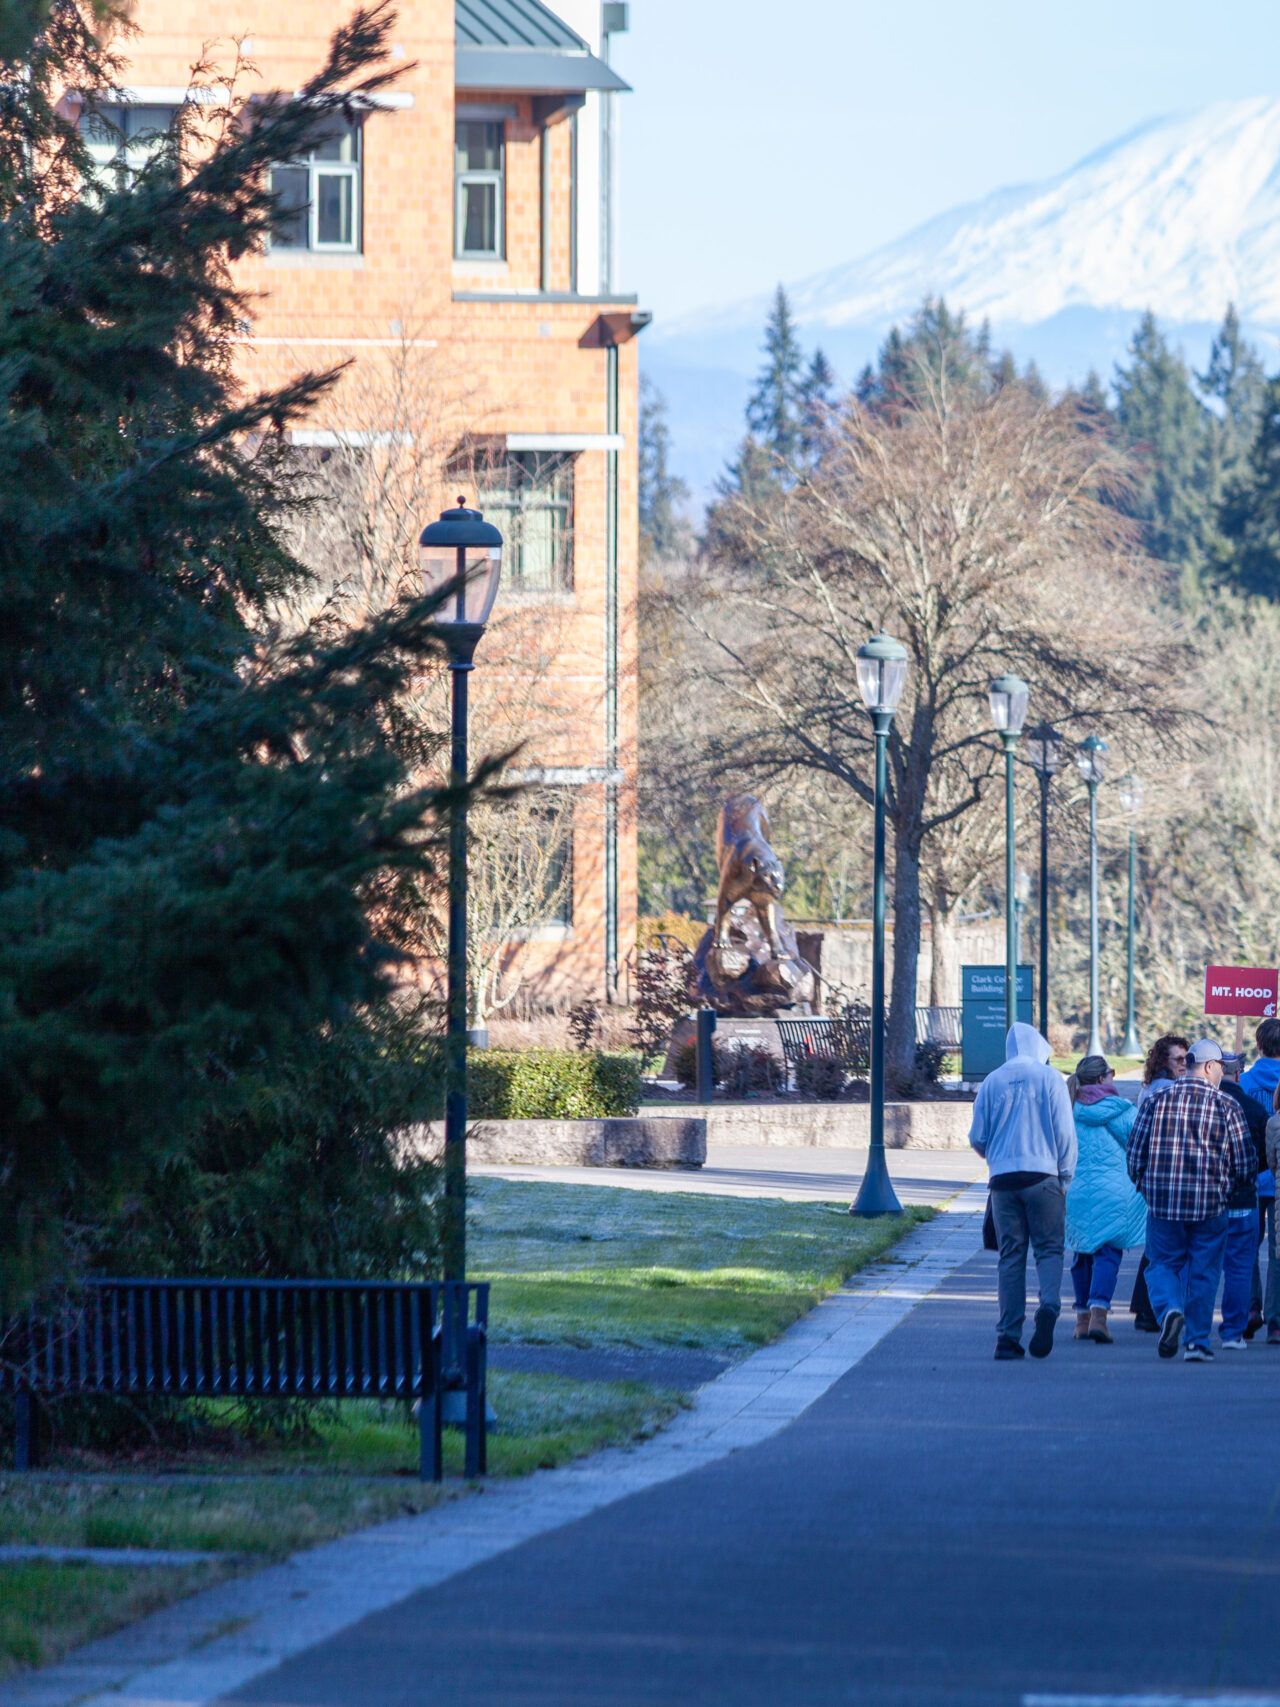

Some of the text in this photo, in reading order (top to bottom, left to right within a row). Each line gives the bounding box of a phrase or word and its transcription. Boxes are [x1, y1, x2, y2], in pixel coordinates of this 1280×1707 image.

[971, 975, 992, 983] Clark
[971, 984, 1003, 994] Building
[1212, 986, 1272, 998] MT. HOOD
